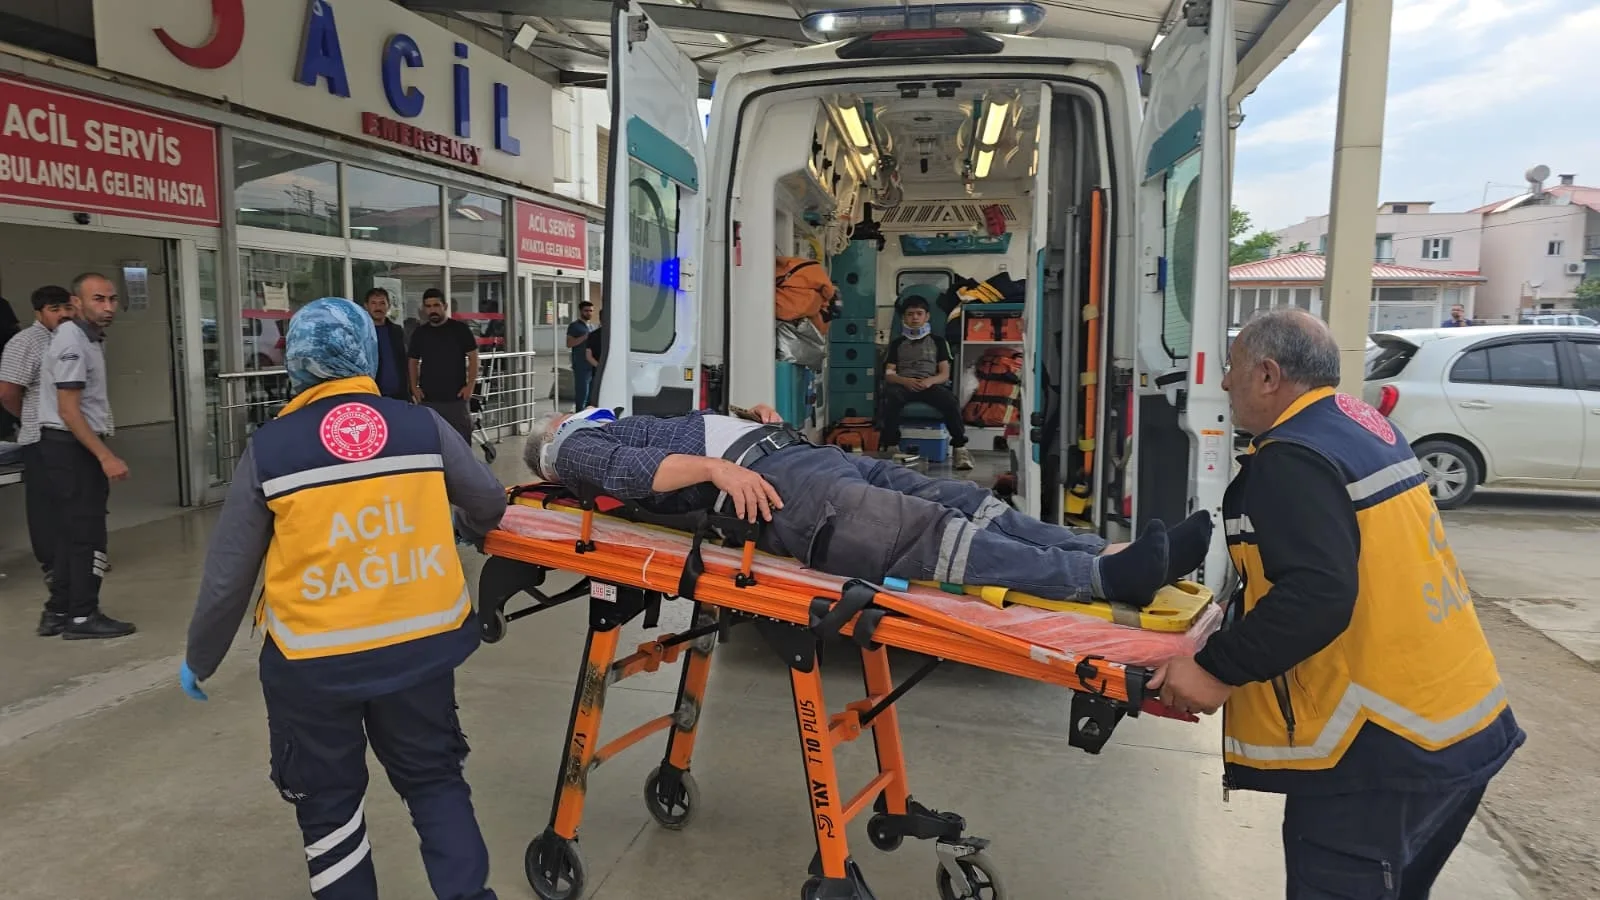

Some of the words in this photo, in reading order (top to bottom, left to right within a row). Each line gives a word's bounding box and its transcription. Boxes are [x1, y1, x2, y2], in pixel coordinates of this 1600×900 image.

[294, 0, 520, 156] ACİL
[3, 103, 78, 148] ACİL
[84, 119, 181, 166] SERVİS
[361, 111, 481, 165] EMERGENCY
[0, 153, 99, 193] BULANSLA
[102, 169, 155, 200] GELEN
[158, 178, 206, 208] HASTA
[528, 213, 547, 234] ACİL
[548, 218, 575, 239] SERVİS
[328, 496, 415, 547] ACİL
[301, 545, 446, 601] SAĞLIK
[800, 699, 819, 734] PLUS
[806, 739, 821, 753] 10
[812, 778, 830, 809] TAY
